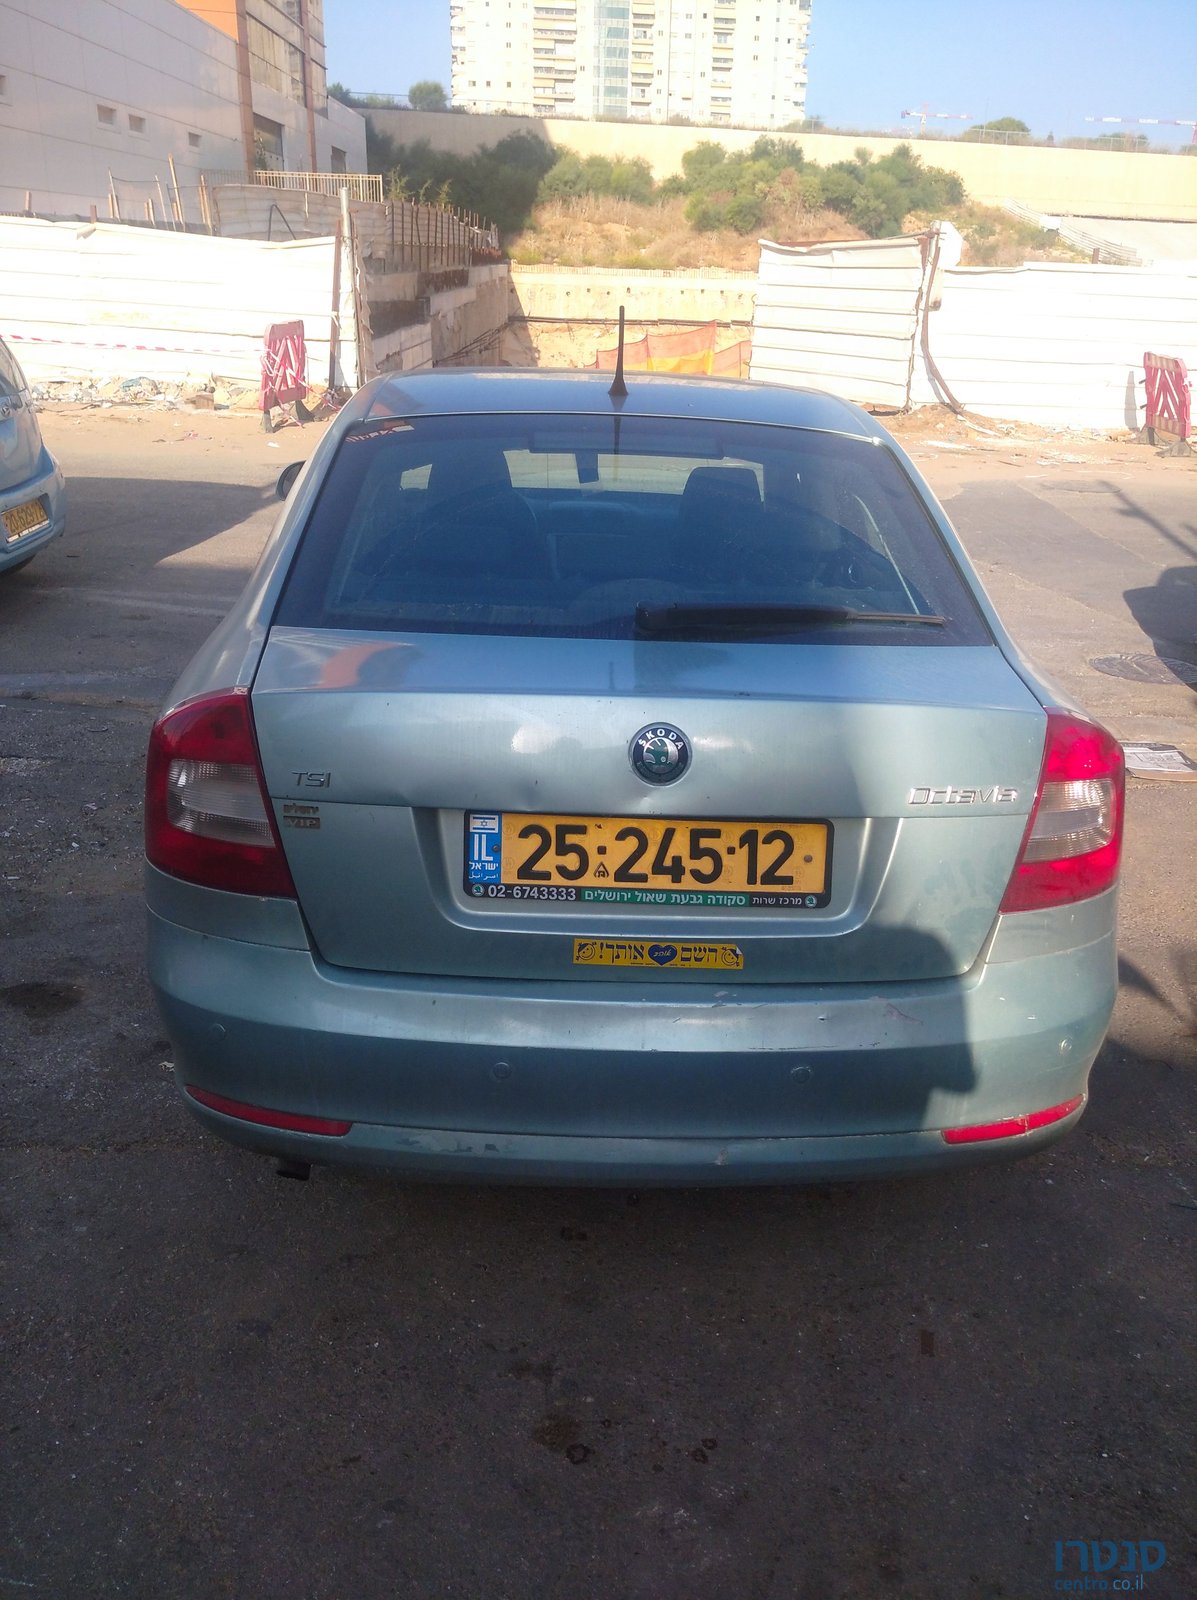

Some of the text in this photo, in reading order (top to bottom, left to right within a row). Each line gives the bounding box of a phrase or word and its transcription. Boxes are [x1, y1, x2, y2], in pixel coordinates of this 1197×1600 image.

[638, 728, 684, 750] SKODA
[291, 771, 331, 788] TSI
[908, 785, 1018, 805] Octavia
[473, 834, 493, 861] IL
[468, 861, 499, 871] ישראל
[487, 885, 802, 906] מרכז שרות סקודה גבעת שאול ירושלים 02-6743333
[680, 945, 718, 963] השם
